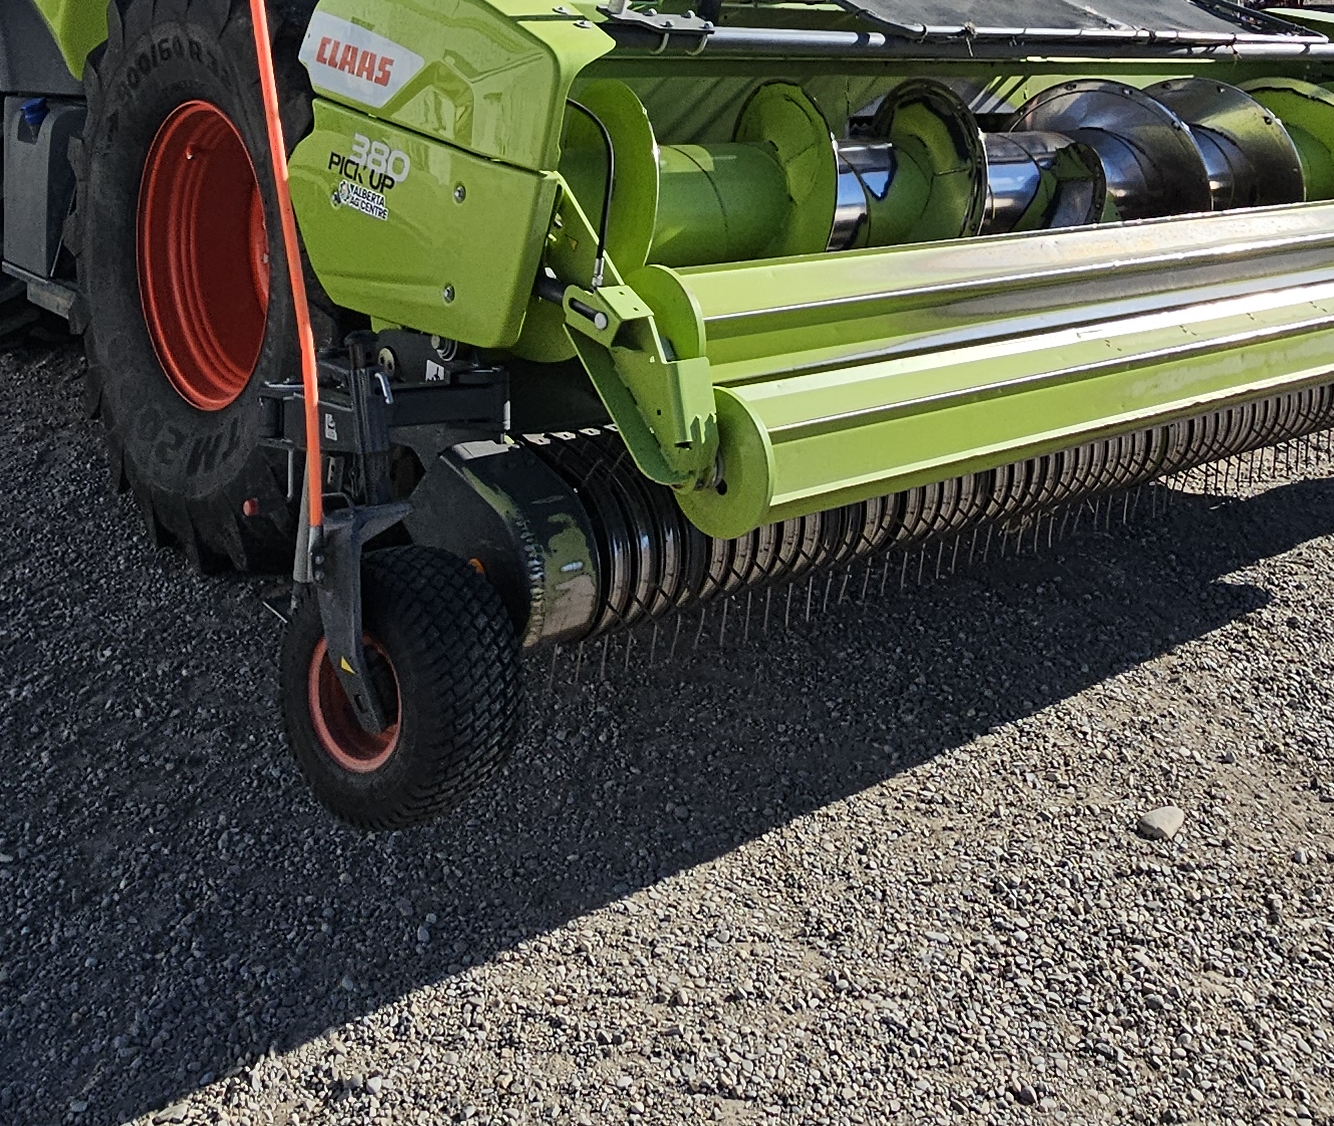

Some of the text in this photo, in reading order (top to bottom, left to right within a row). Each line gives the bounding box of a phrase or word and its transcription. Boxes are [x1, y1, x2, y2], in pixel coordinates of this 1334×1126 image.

[315, 36, 395, 88] CLAAS
[349, 132, 411, 183] 380
[350, 185, 386, 208] ALBERTA
[360, 199, 388, 220] CENTRE
